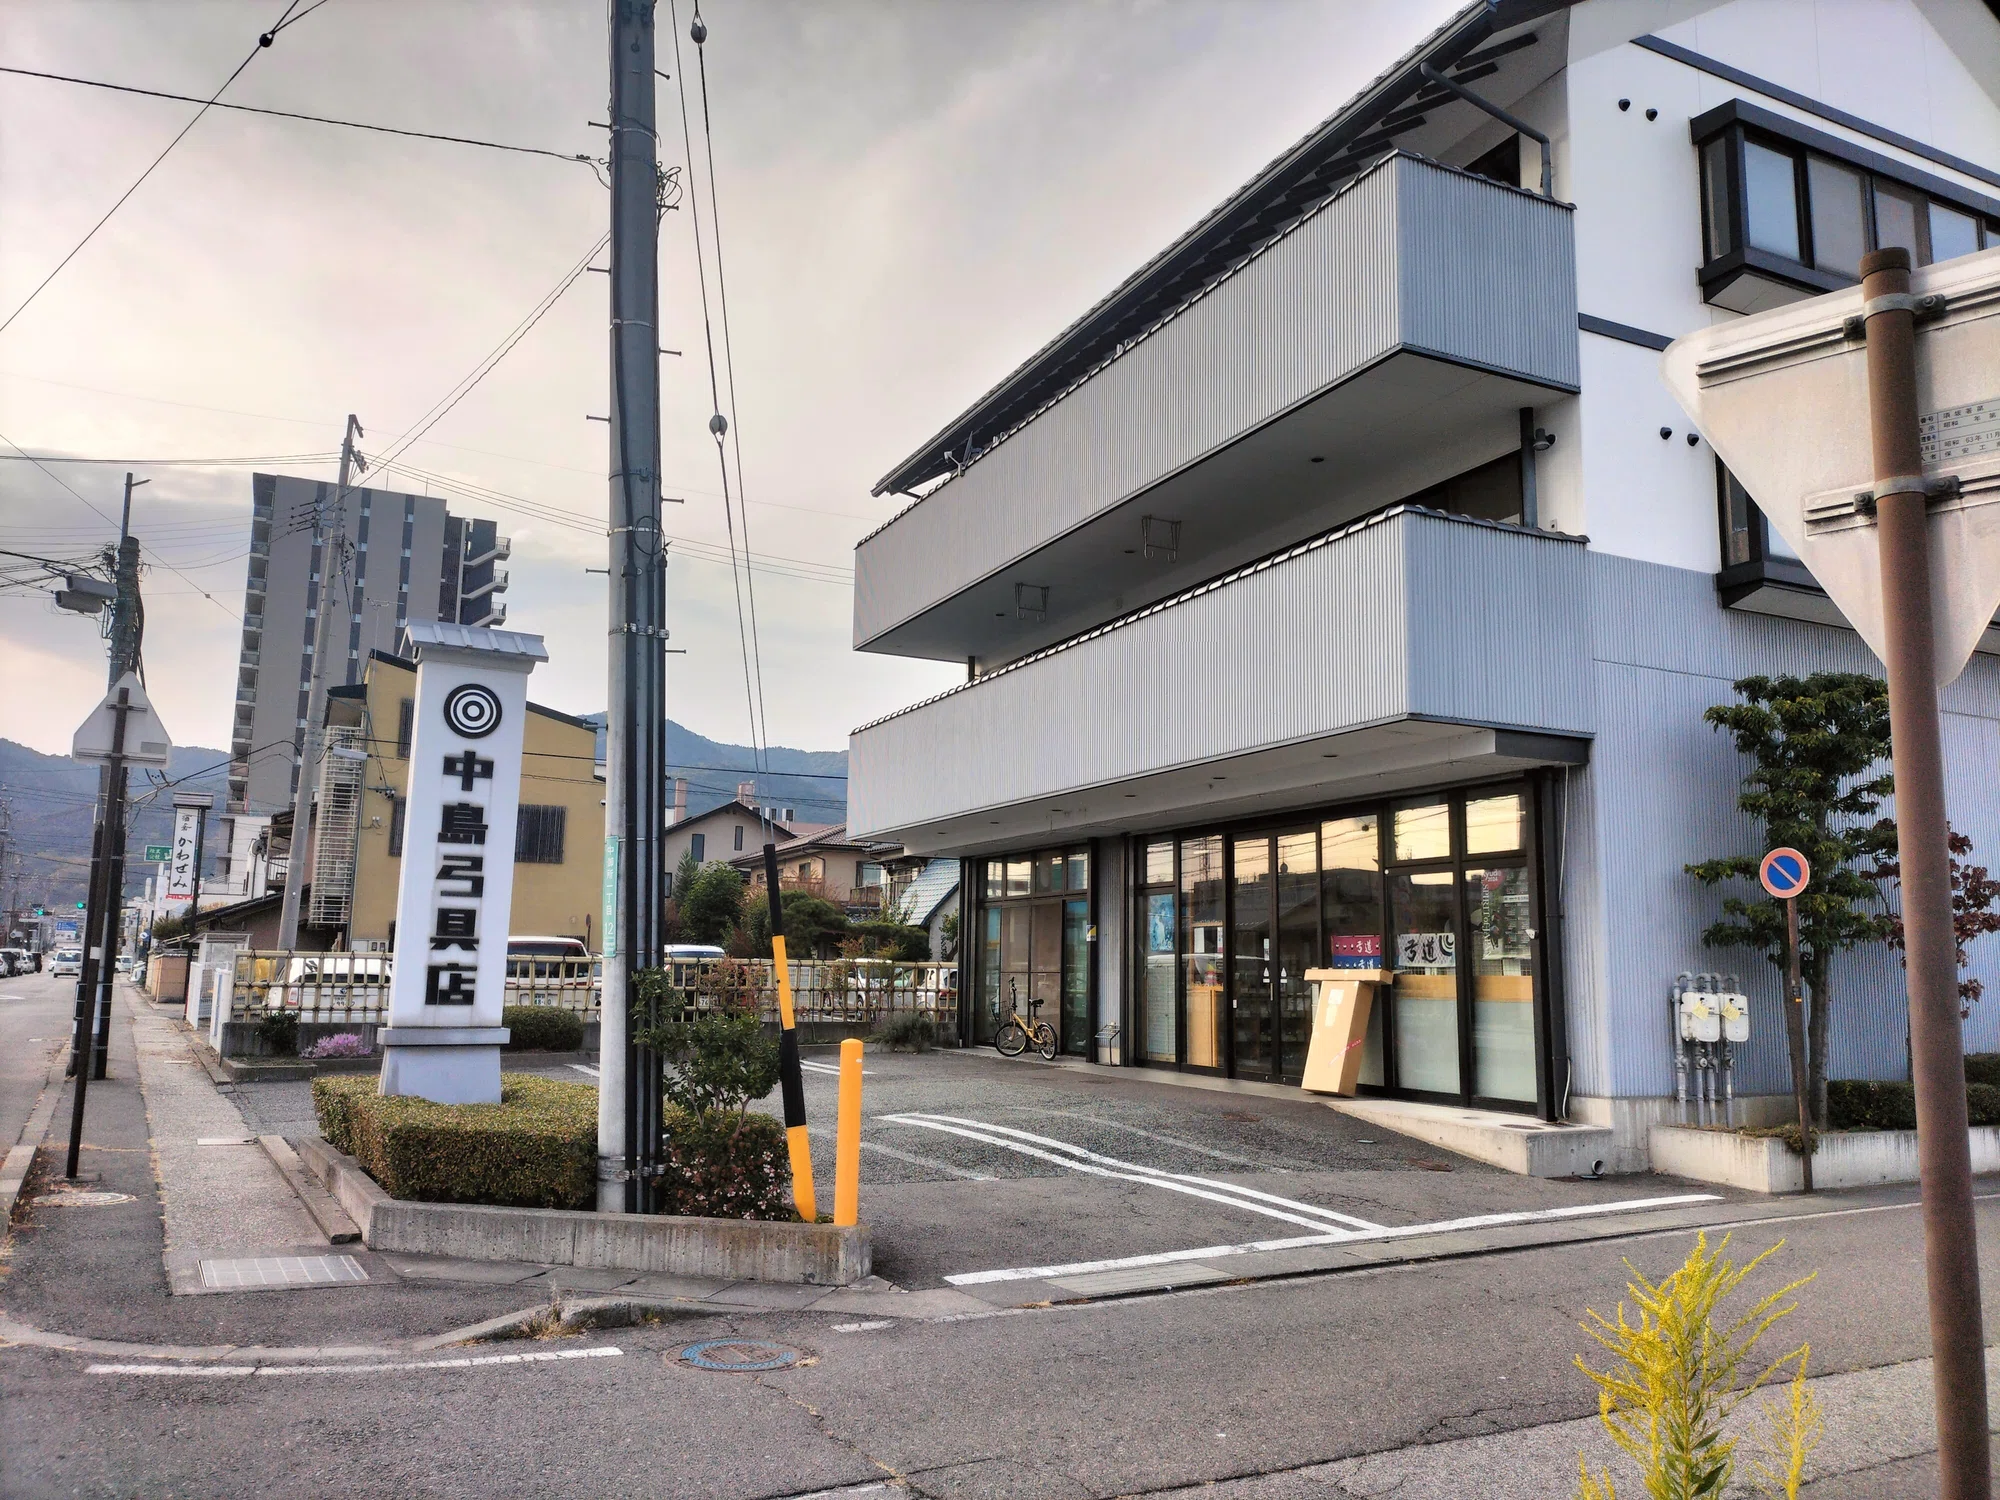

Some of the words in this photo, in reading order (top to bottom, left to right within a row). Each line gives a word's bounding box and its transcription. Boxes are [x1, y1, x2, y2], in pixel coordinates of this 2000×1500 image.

[173, 837, 193, 888] かわせみ
[425, 750, 494, 1005] 中島弓具店
[604, 922, 614, 935] 12
[1355, 939, 1373, 954] 弓道
[1404, 936, 1437, 963] 弓道
